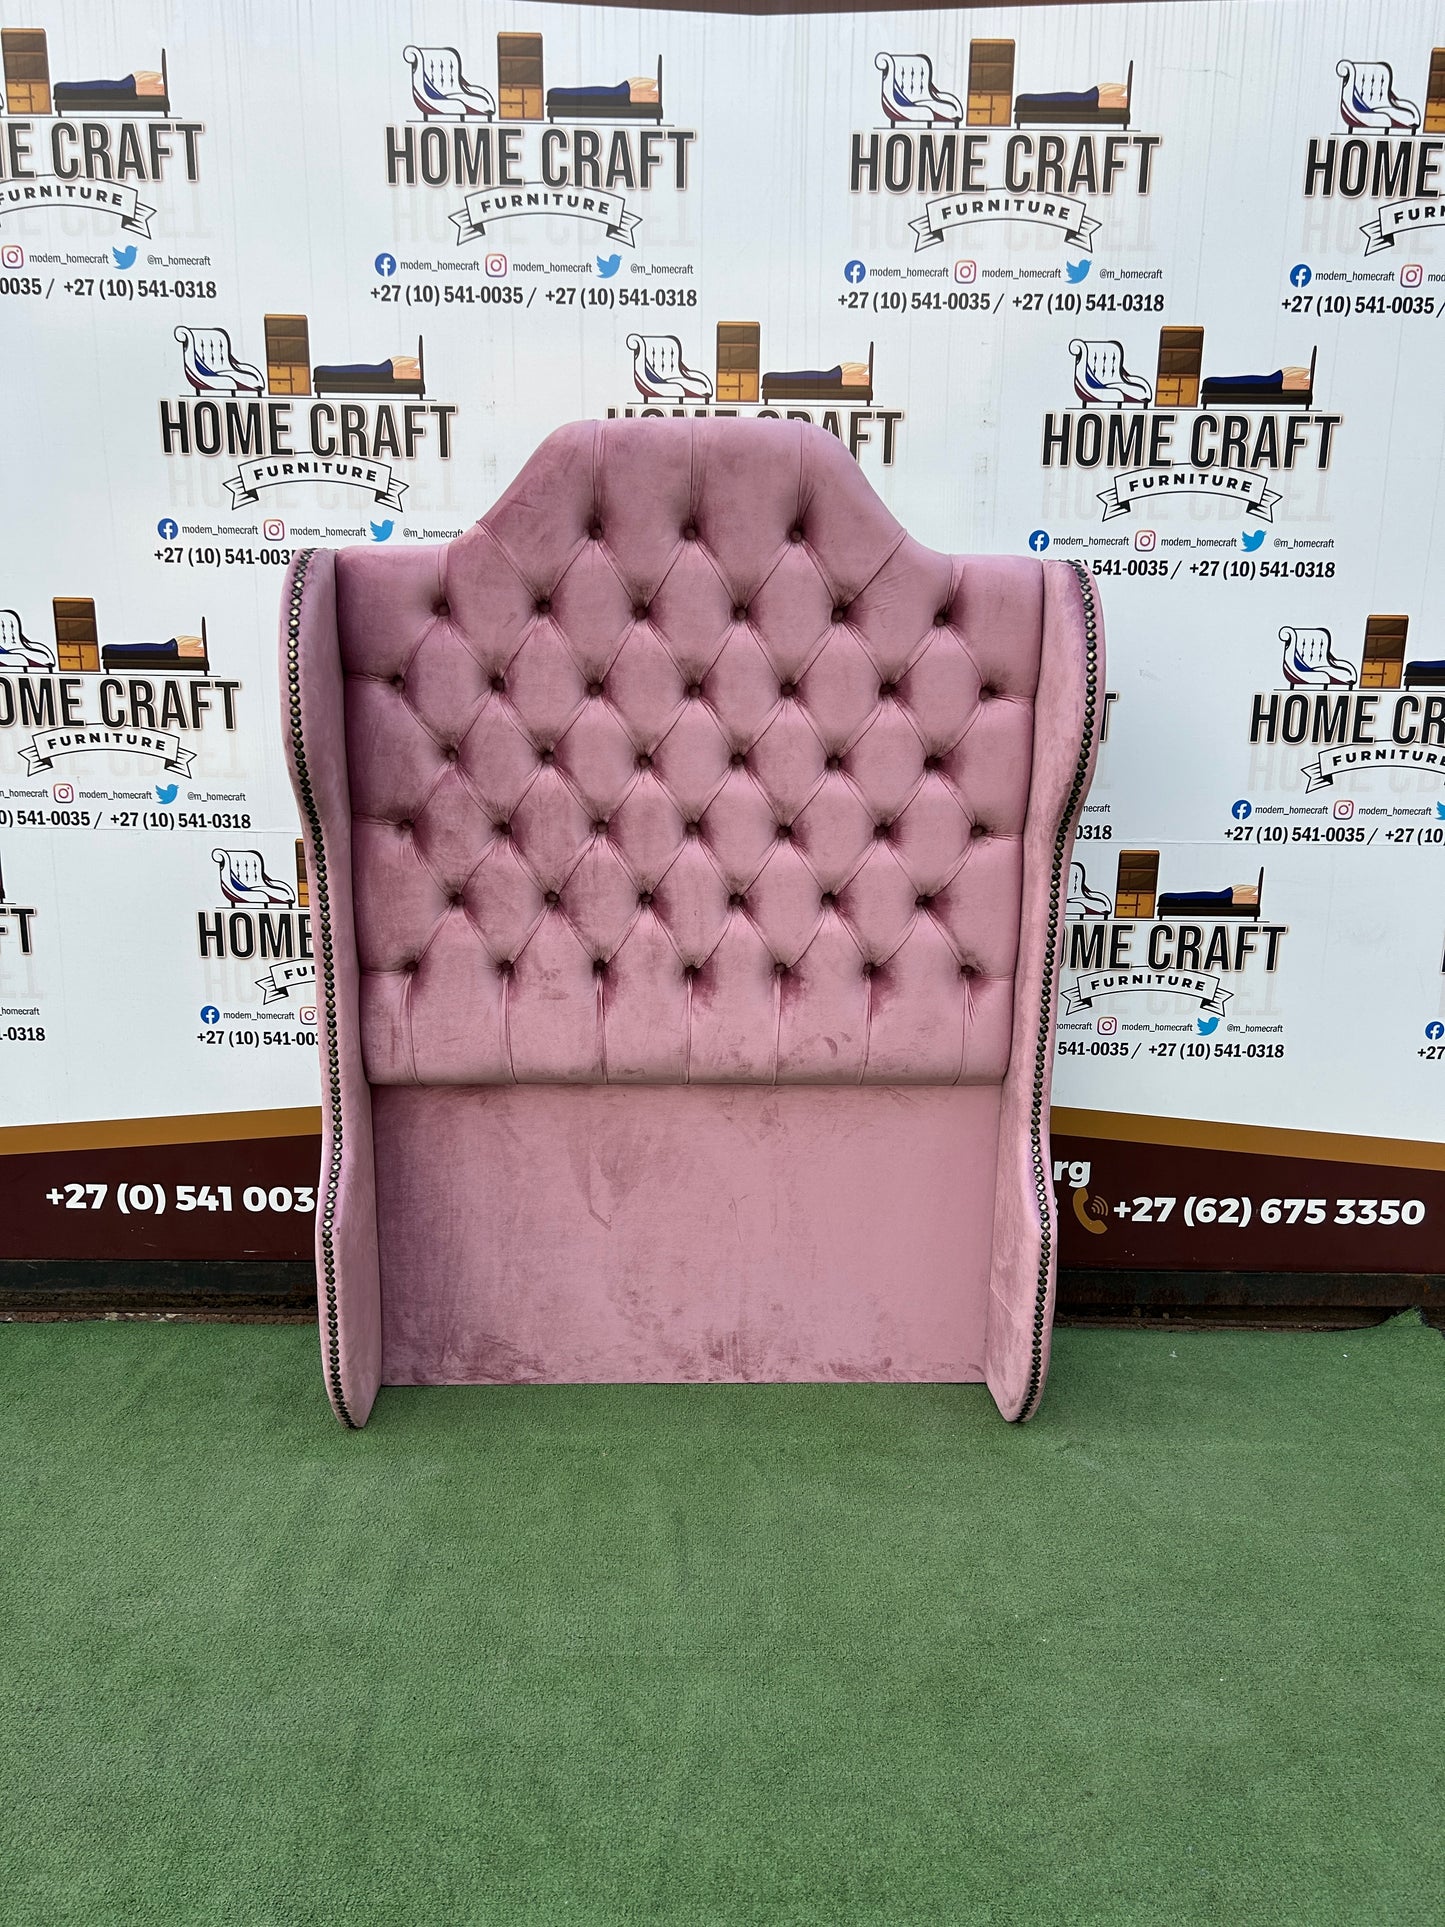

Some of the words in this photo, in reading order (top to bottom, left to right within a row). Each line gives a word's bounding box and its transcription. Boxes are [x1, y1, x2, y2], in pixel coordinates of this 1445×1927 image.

[48, 122, 202, 183] CRAFT
[386, 127, 522, 187] HOME
[542, 129, 694, 192] CRAFT
[851, 134, 991, 195] HOME
[1005, 135, 1160, 197] CRAFT
[1305, 139, 1445, 199] HOME
[480, 193, 610, 215] FURNITURE
[941, 199, 1070, 221] FURNITURE
[147, 255, 211, 267] @m_homecraft
[630, 263, 694, 276] @m_homecraft
[1099, 269, 1163, 281] @m_homecraft
[64, 278, 94, 296] +27
[99, 279, 133, 301] (10)
[138, 280, 217, 298] 541-0318
[370, 284, 401, 302] +27
[406, 285, 440, 307] (10)
[444, 286, 523, 304] 541-0035
[545, 287, 576, 305] +27
[581, 288, 614, 309] (10)
[619, 288, 697, 307] 541-0318
[838, 291, 869, 309] +27
[873, 292, 907, 313] (10)
[911, 292, 990, 310] 541-0035
[1012, 293, 1044, 310] +27
[1047, 293, 1081, 315] (10)
[1085, 294, 1164, 312] 541-0318
[1282, 295, 1313, 313] +27
[1317, 296, 1351, 317] (10)
[1355, 296, 1434, 314] 541-0035
[160, 401, 293, 455] HOME
[310, 403, 455, 459] CRAFT
[1042, 413, 1178, 469] HOME
[1191, 415, 1340, 471] CRAFT
[253, 462, 378, 482] FURNITURE
[1129, 473, 1253, 493] FURNITURE
[1274, 538, 1334, 549] @m_homecraft
[154, 547, 183, 563] +27
[188, 548, 221, 568] (10)
[224, 549, 297, 565] 541-003
[1092, 559, 1168, 576] 541-0035
[1189, 560, 1220, 576] +27
[1223, 561, 1256, 581] (10)
[1259, 561, 1335, 578] 541-0318
[100, 679, 239, 730] CRAFT
[1250, 694, 1381, 745] HOME
[47, 732, 166, 751] FURNITURE
[187, 792, 246, 802] @m_homecraft
[17, 810, 90, 826] 541-0035
[110, 812, 139, 826] +27
[143, 812, 174, 831] (10)
[178, 813, 251, 829] 541-0318
[1224, 826, 1253, 841] +27
[1257, 826, 1288, 844] (10)
[1291, 827, 1365, 842] 541-0035
[1385, 828, 1414, 843] +27
[1417, 828, 1445, 846] (10
[1148, 925, 1286, 973] CRAFT
[1090, 974, 1205, 991] FURNITURE
[197, 1030, 224, 1044] +27
[229, 1031, 259, 1048] (10)
[1227, 1024, 1283, 1034] @m_homecraft
[1058, 1042, 1129, 1056] 541-0035
[1148, 1043, 1177, 1056] +27
[1180, 1043, 1210, 1060] (10)
[1214, 1044, 1284, 1058] 541-0318
[46, 1183, 108, 1209] +27
[117, 1183, 166, 1214] (0)
[176, 1186, 232, 1211] 541
[242, 1186, 320, 1213] 003
[1114, 1197, 1176, 1222] +27
[1184, 1196, 1252, 1227] (62)
[1260, 1198, 1326, 1224] 675
[1333, 1199, 1425, 1225] 3350
